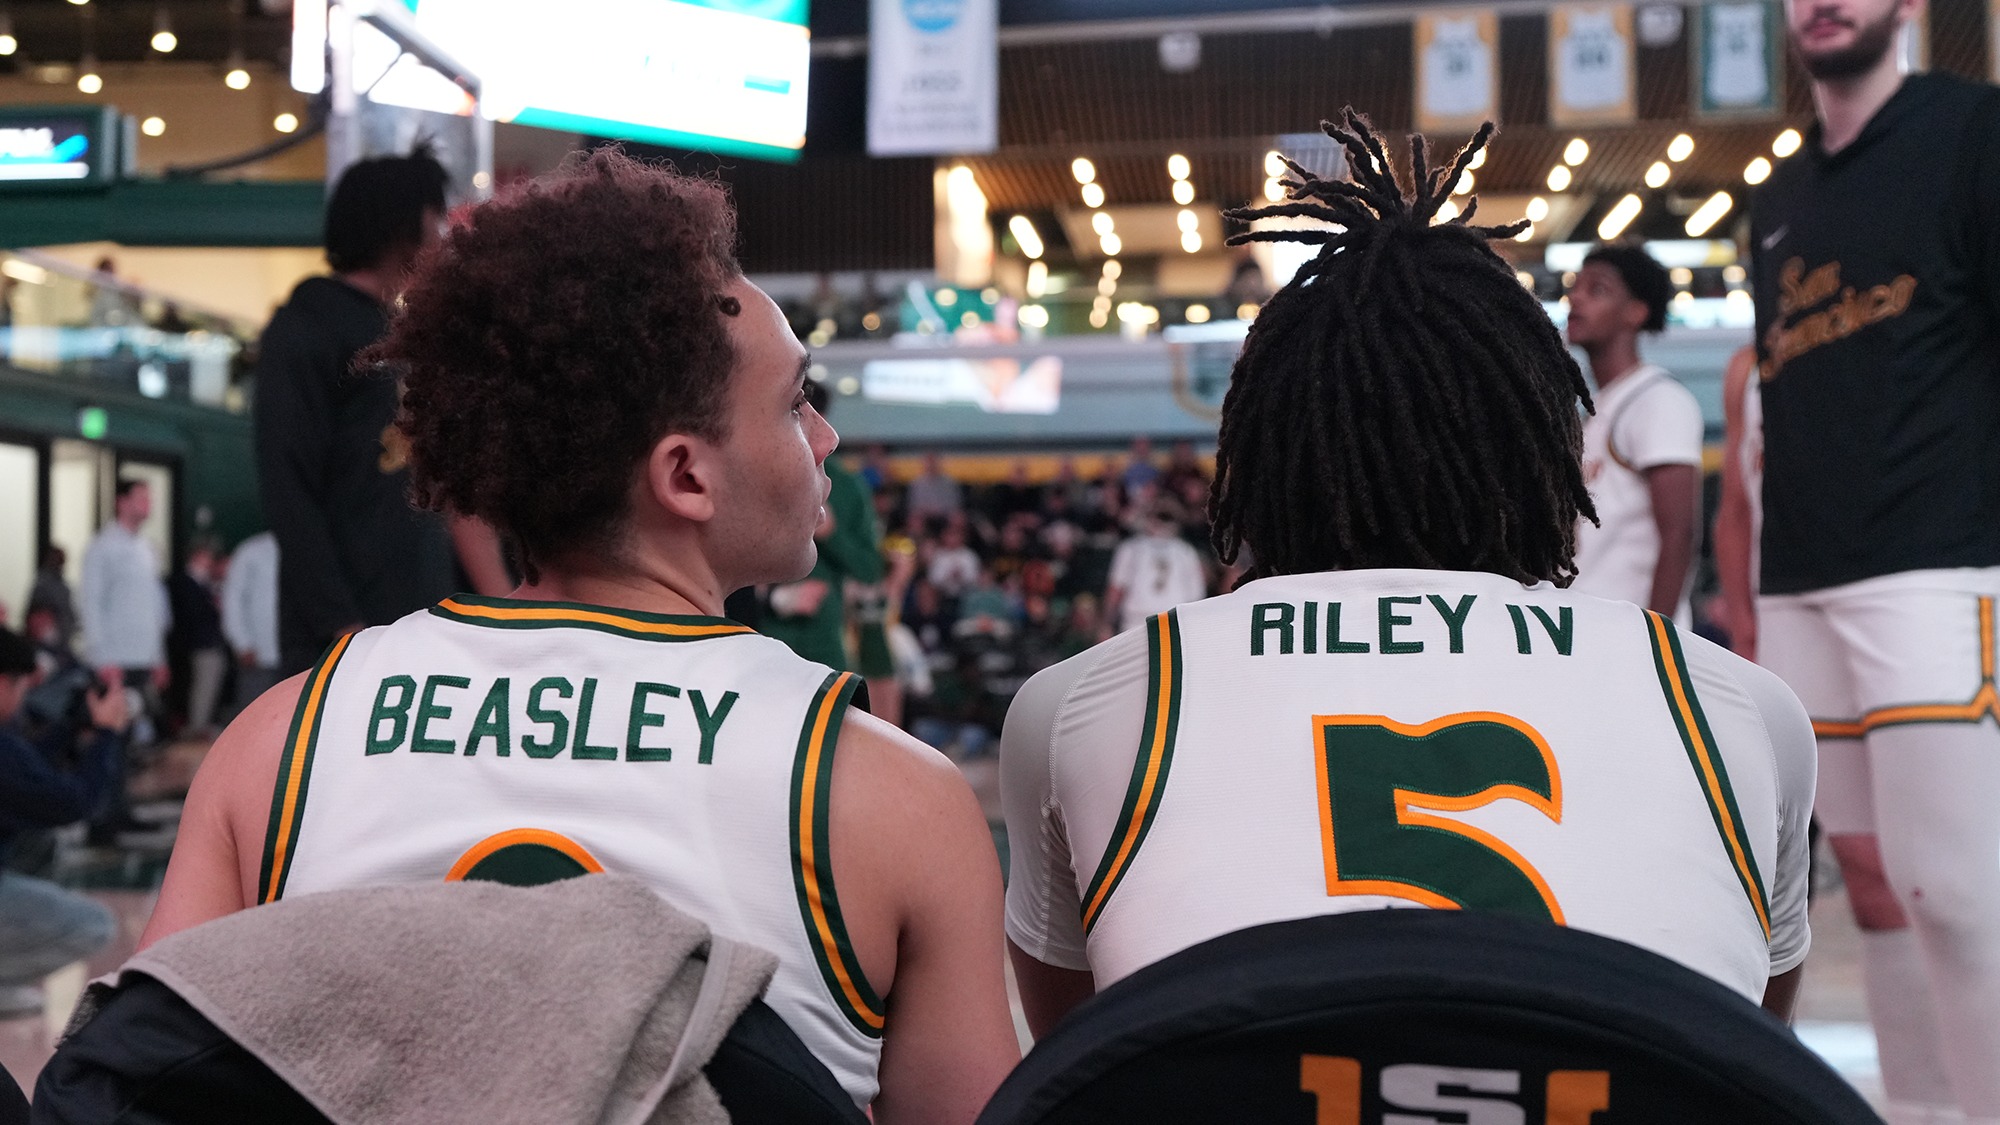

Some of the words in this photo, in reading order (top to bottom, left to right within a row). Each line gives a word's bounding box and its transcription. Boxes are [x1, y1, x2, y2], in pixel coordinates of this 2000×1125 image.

[1778, 256, 1841, 316] San
[1251, 594, 1477, 656] RILEY
[1505, 603, 1573, 656] IV
[365, 675, 740, 765] BEASLEY
[1312, 711, 1568, 927] 5
